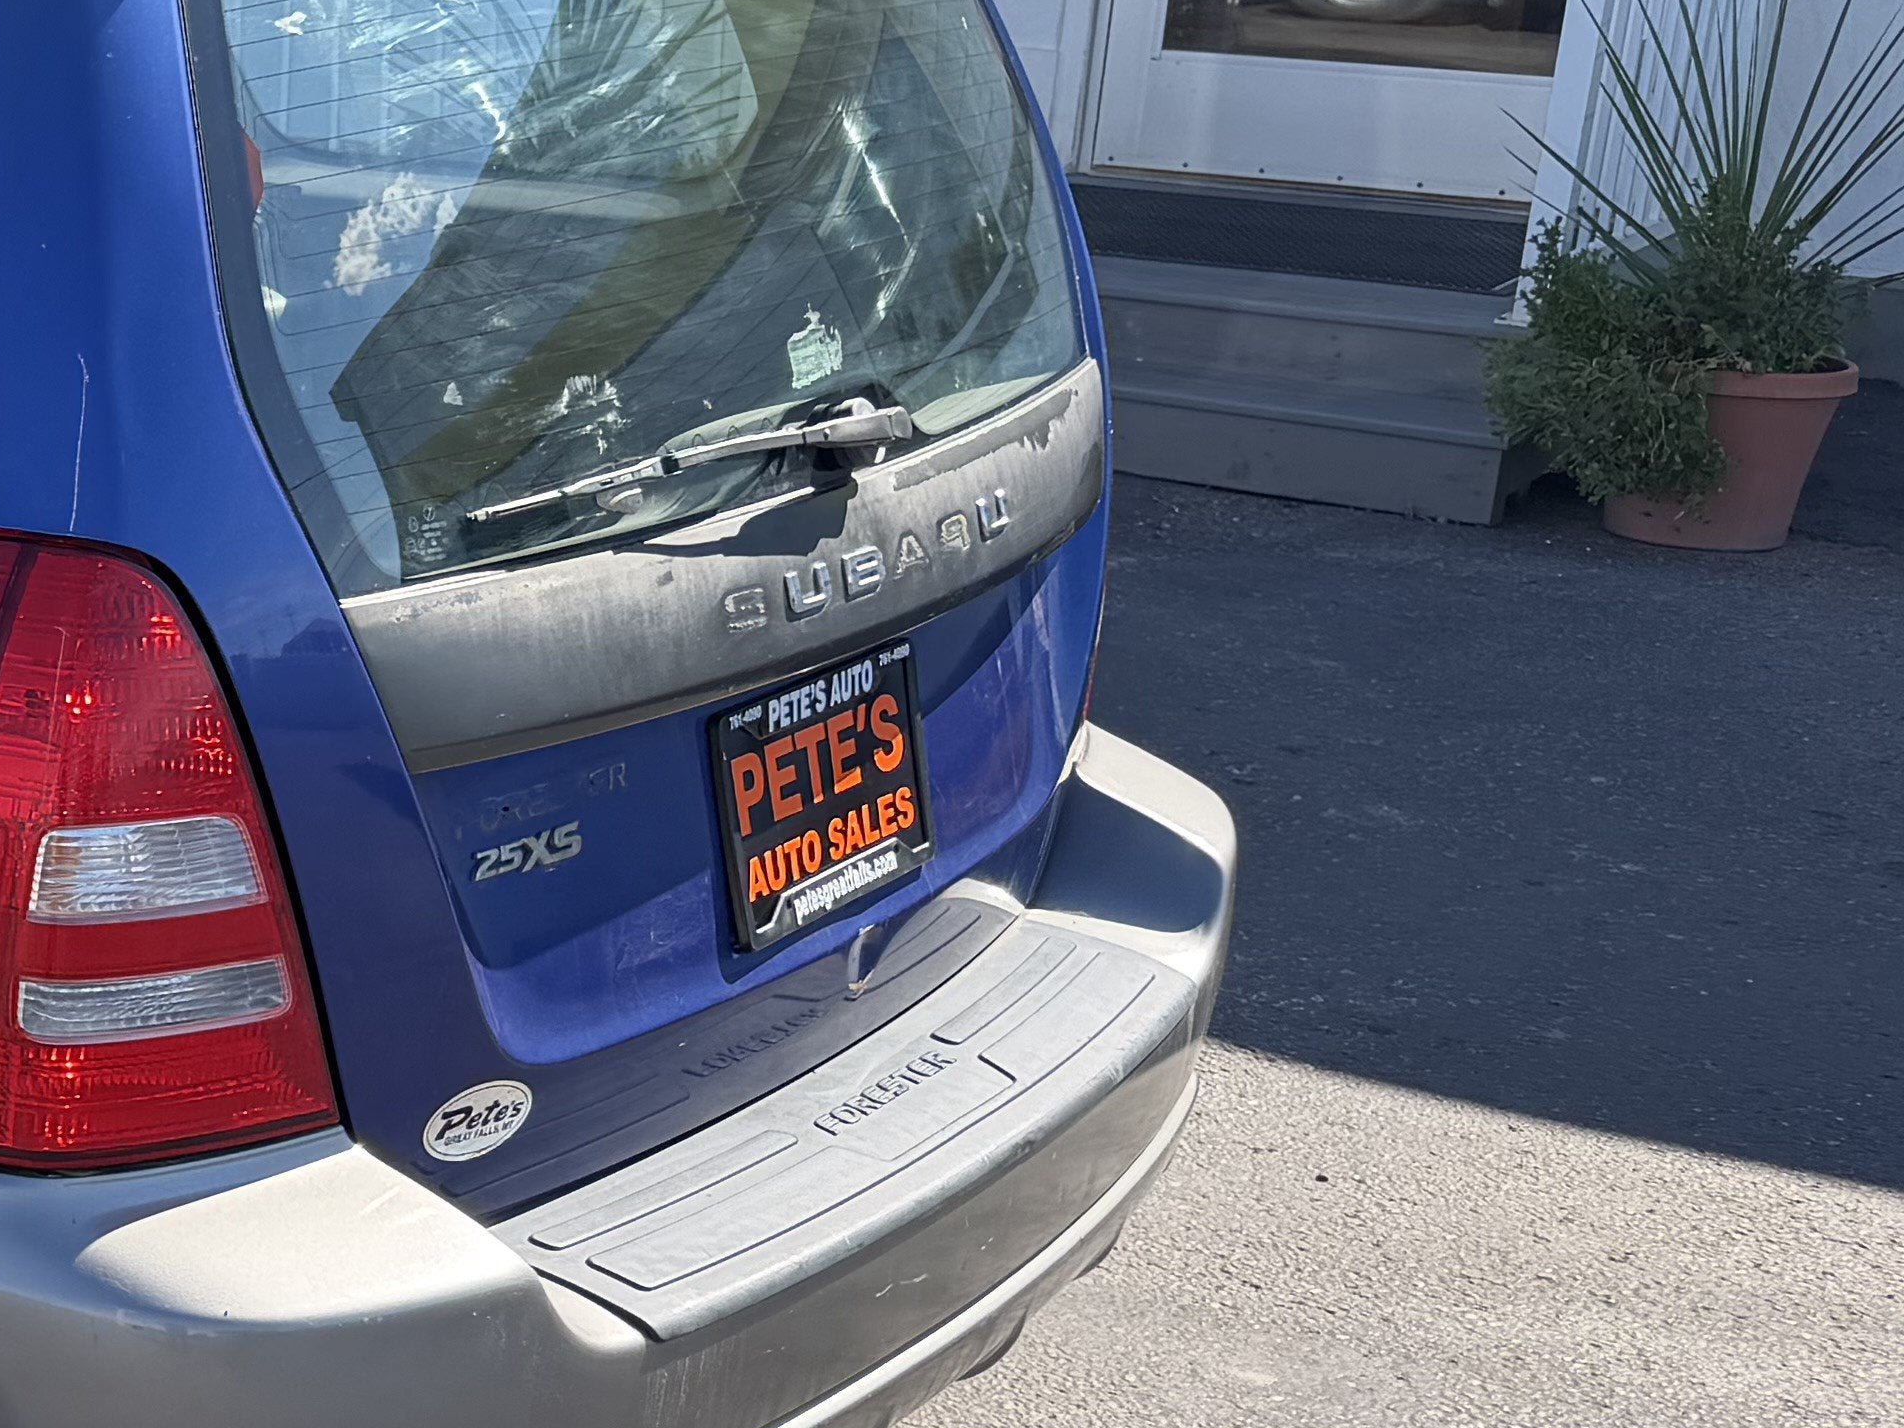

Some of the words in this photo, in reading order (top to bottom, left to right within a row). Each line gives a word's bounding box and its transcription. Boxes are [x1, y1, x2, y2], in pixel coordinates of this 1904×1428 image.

[722, 487, 1010, 633] SUBARU
[768, 679, 827, 733] PETE'S
[830, 659, 874, 707] AUTO
[730, 693, 906, 838] PETE'S
[748, 829, 823, 904] AUTO
[827, 785, 916, 862] SALES
[793, 850, 898, 926] petesgreatfalls.com
[434, 1098, 525, 1142] Pete's
[812, 1049, 958, 1137] FORESTER
